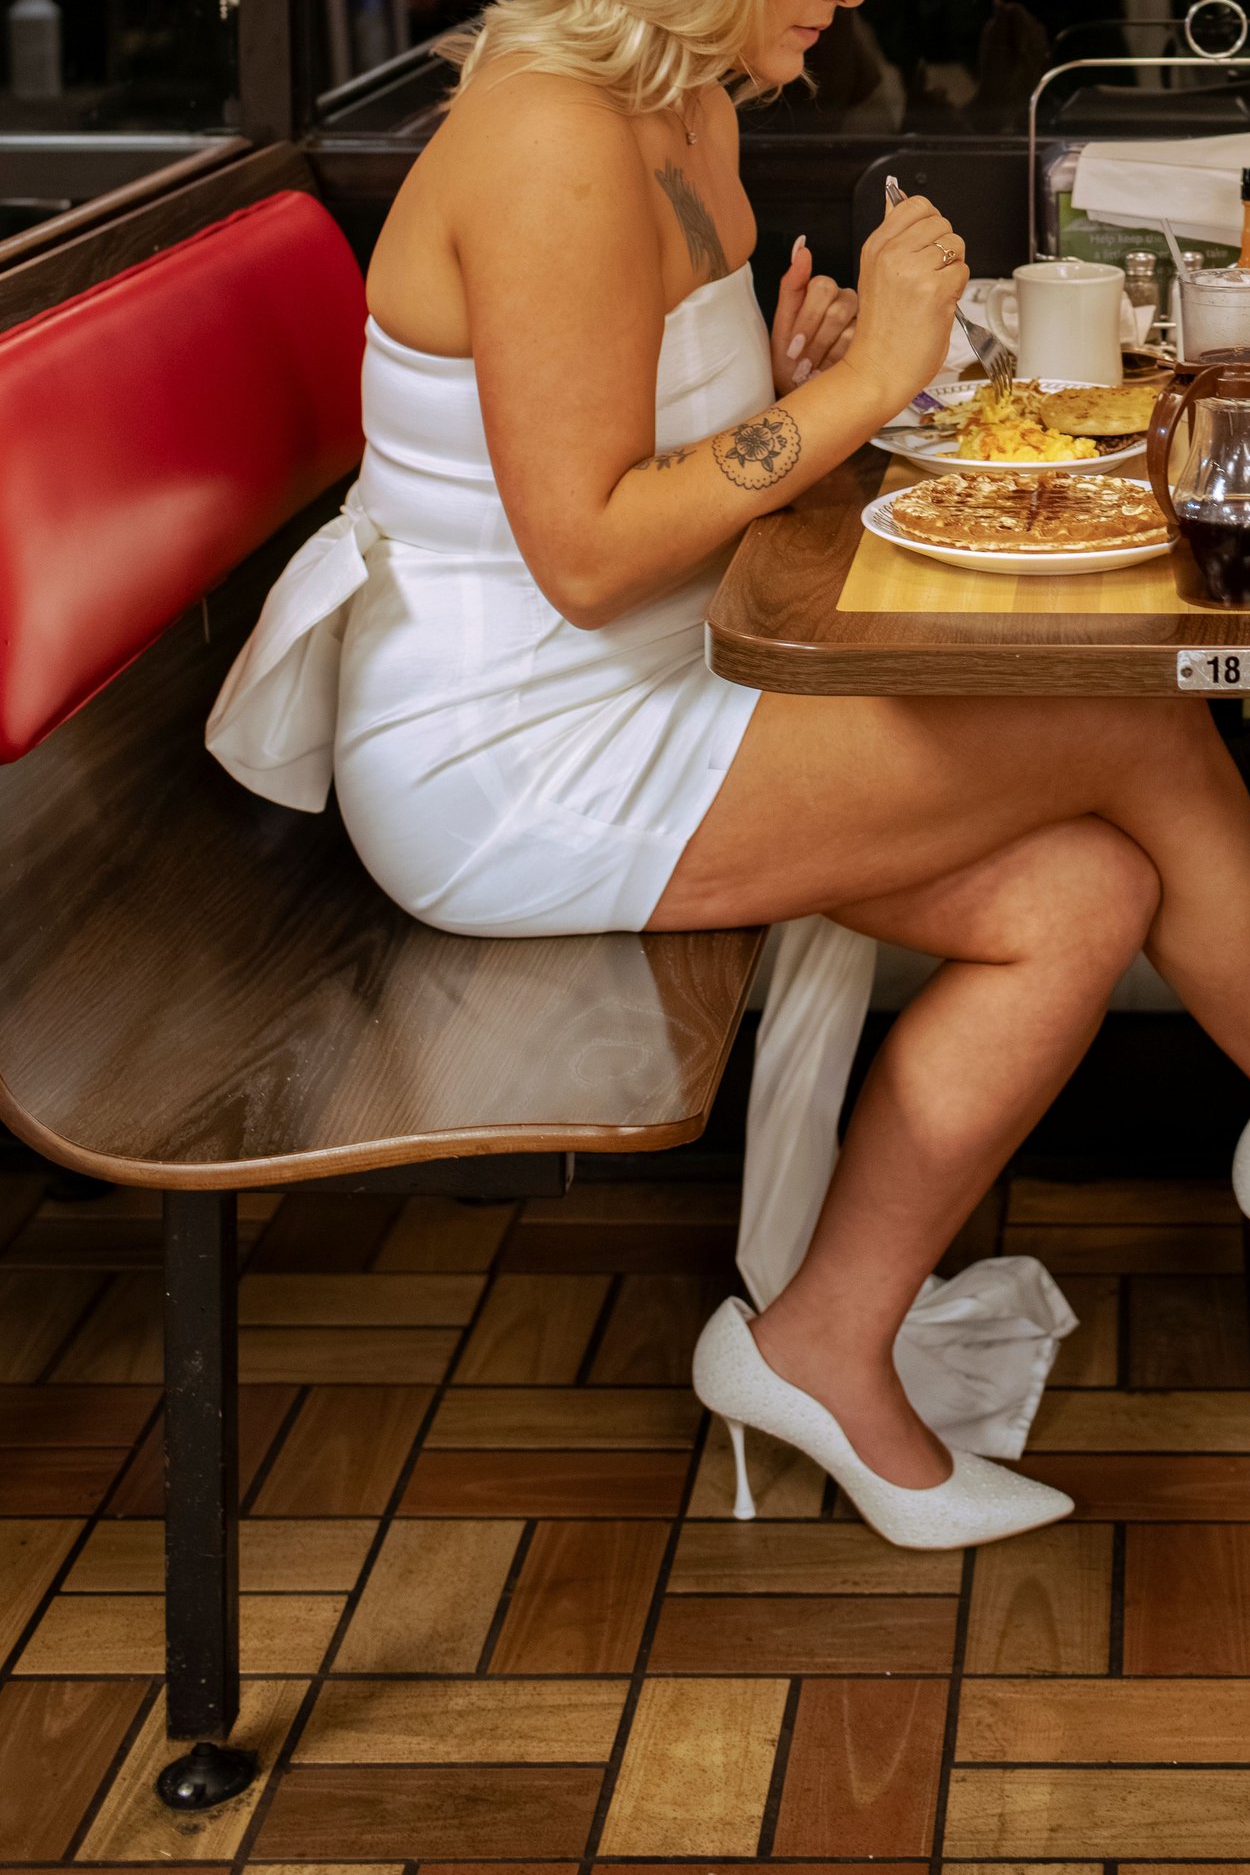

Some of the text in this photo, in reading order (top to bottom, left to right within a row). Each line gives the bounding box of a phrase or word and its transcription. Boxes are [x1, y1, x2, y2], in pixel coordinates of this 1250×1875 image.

[1089, 233, 1116, 246] Help
[1118, 233, 1144, 246] keep
[1206, 655, 1241, 684] 18
